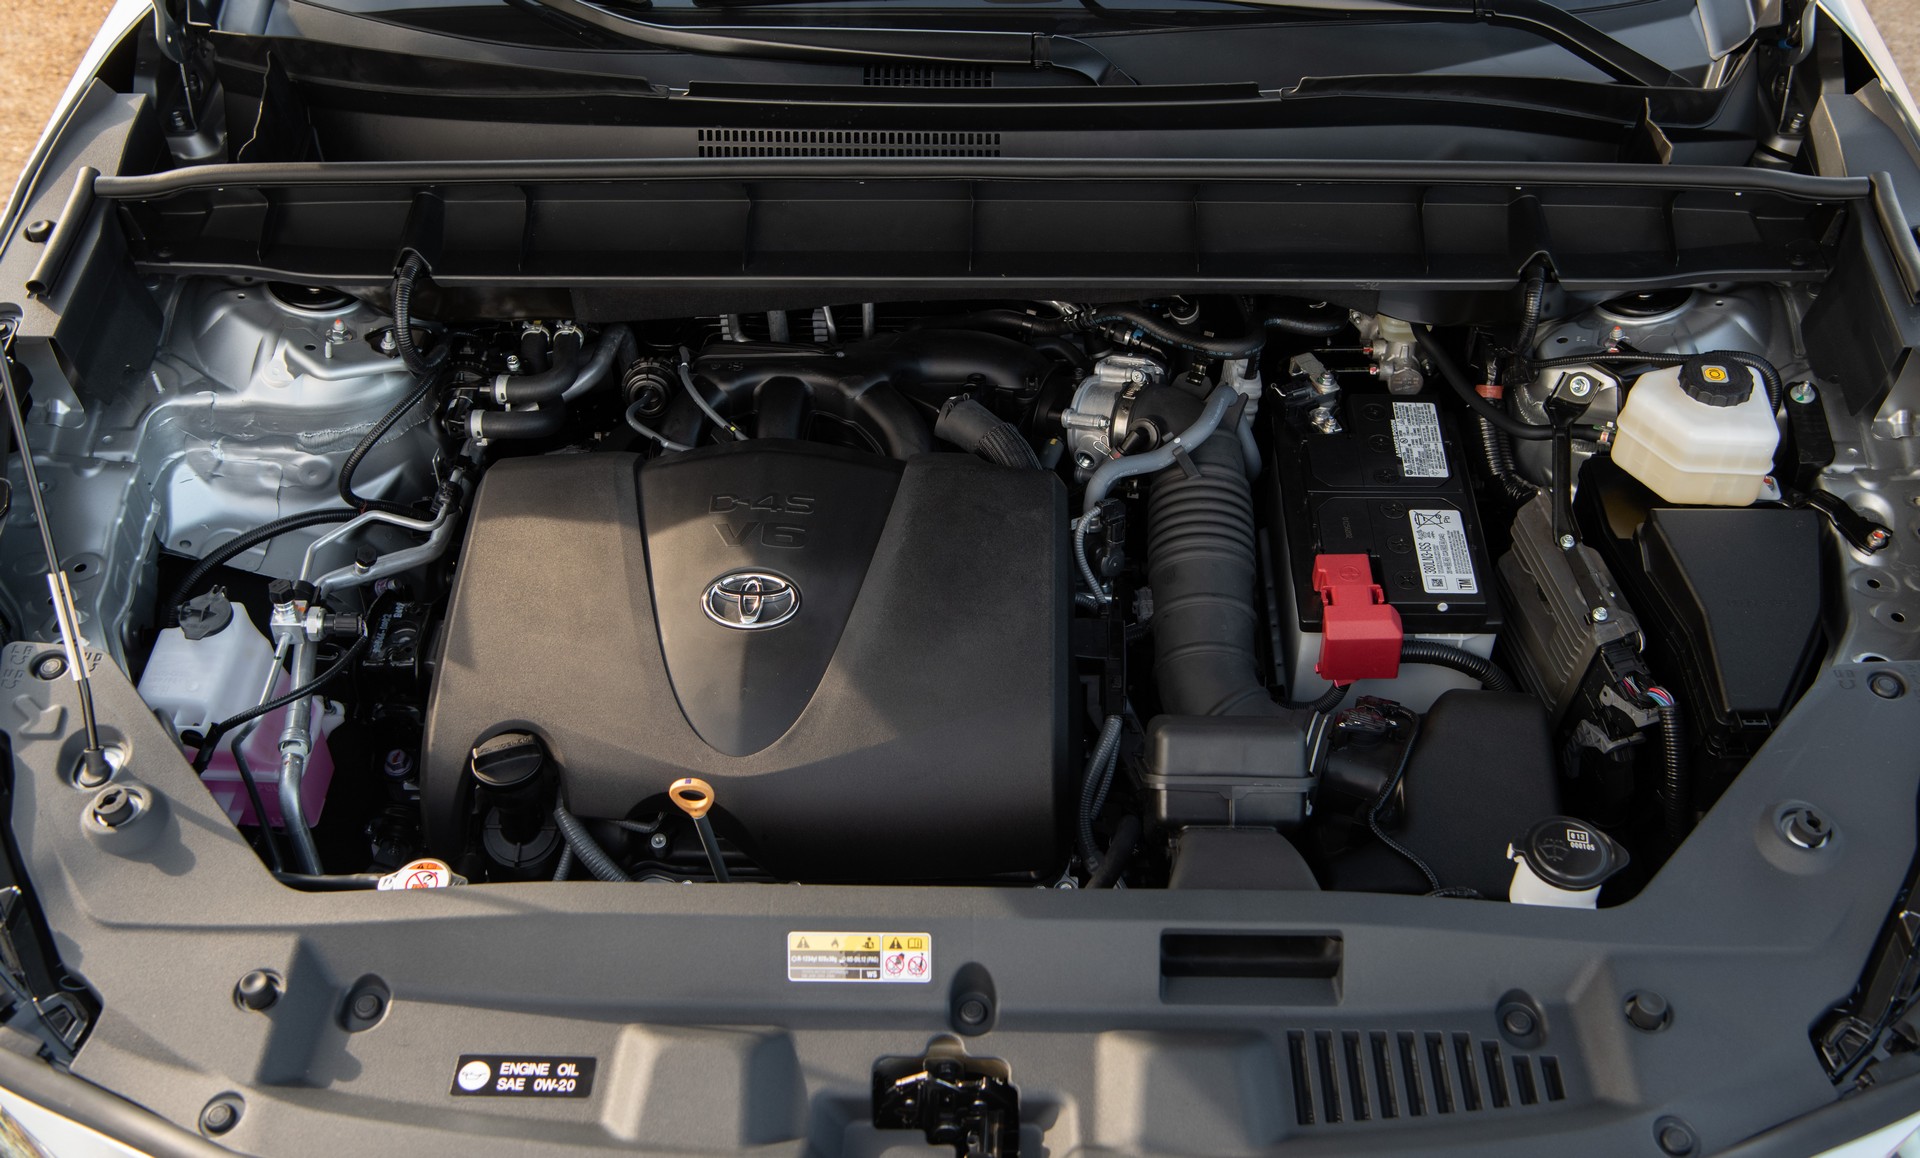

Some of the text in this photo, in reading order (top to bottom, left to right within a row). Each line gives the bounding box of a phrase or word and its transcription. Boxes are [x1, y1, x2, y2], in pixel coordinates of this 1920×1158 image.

[708, 493, 815, 514] D-4S
[712, 521, 808, 549] V6
[1458, 579, 1473, 589] TM
[499, 1062, 579, 1077] ENGINE OIL
[496, 1077, 576, 1092] SAE 0W-20
